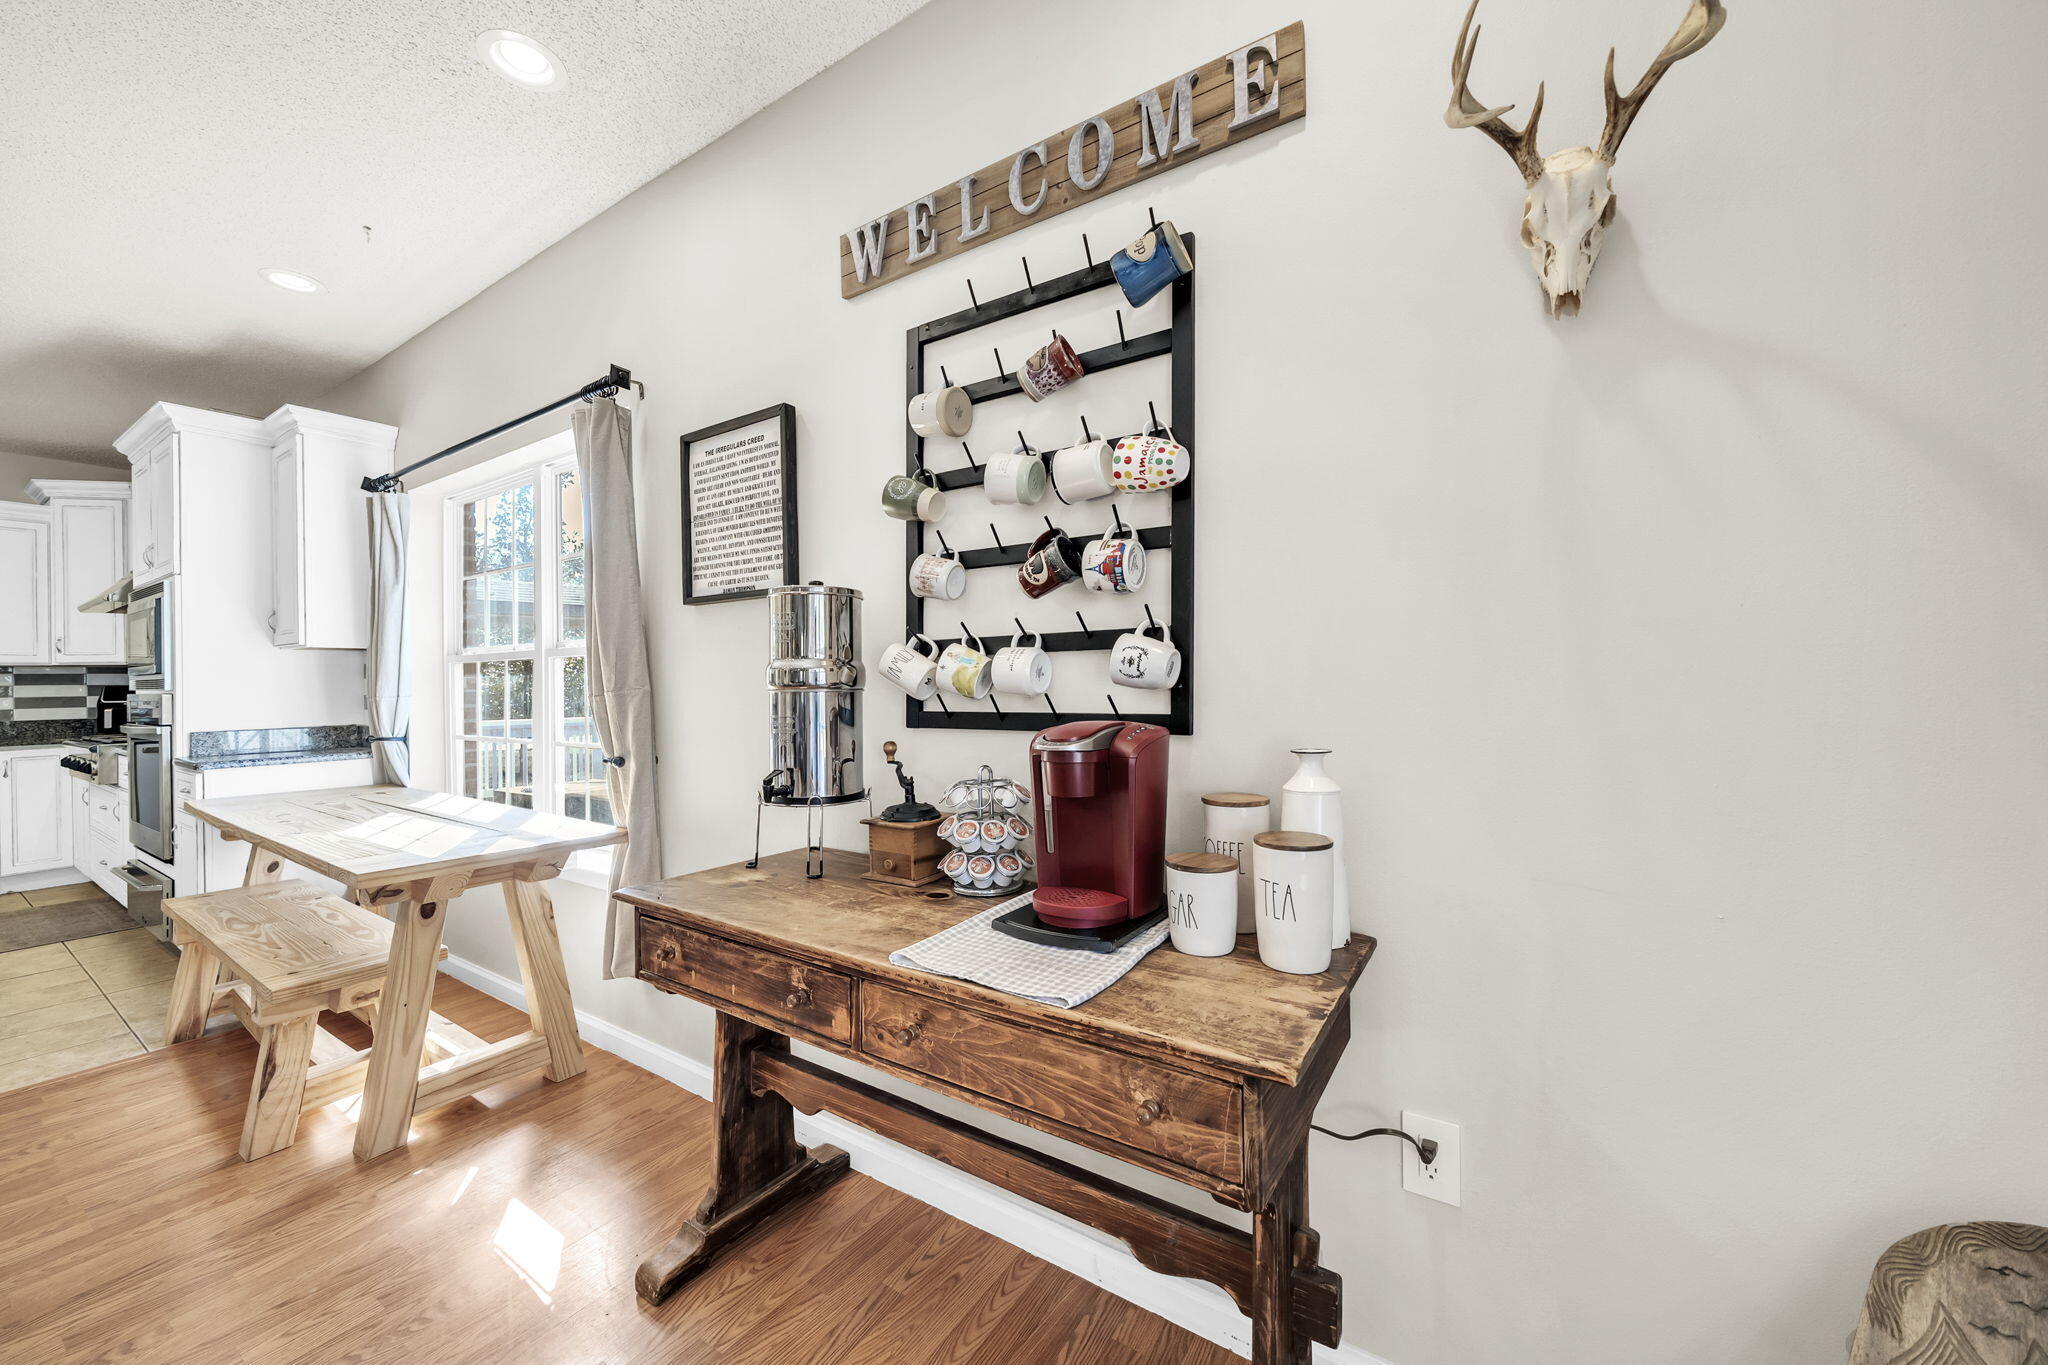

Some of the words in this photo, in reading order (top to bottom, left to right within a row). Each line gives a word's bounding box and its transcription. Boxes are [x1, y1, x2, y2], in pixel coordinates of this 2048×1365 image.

[845, 33, 1280, 284] WELCOME
[716, 440, 746, 454] IRREGULARS
[747, 435, 765, 445] CREED
[1260, 878, 1297, 922] TEA
